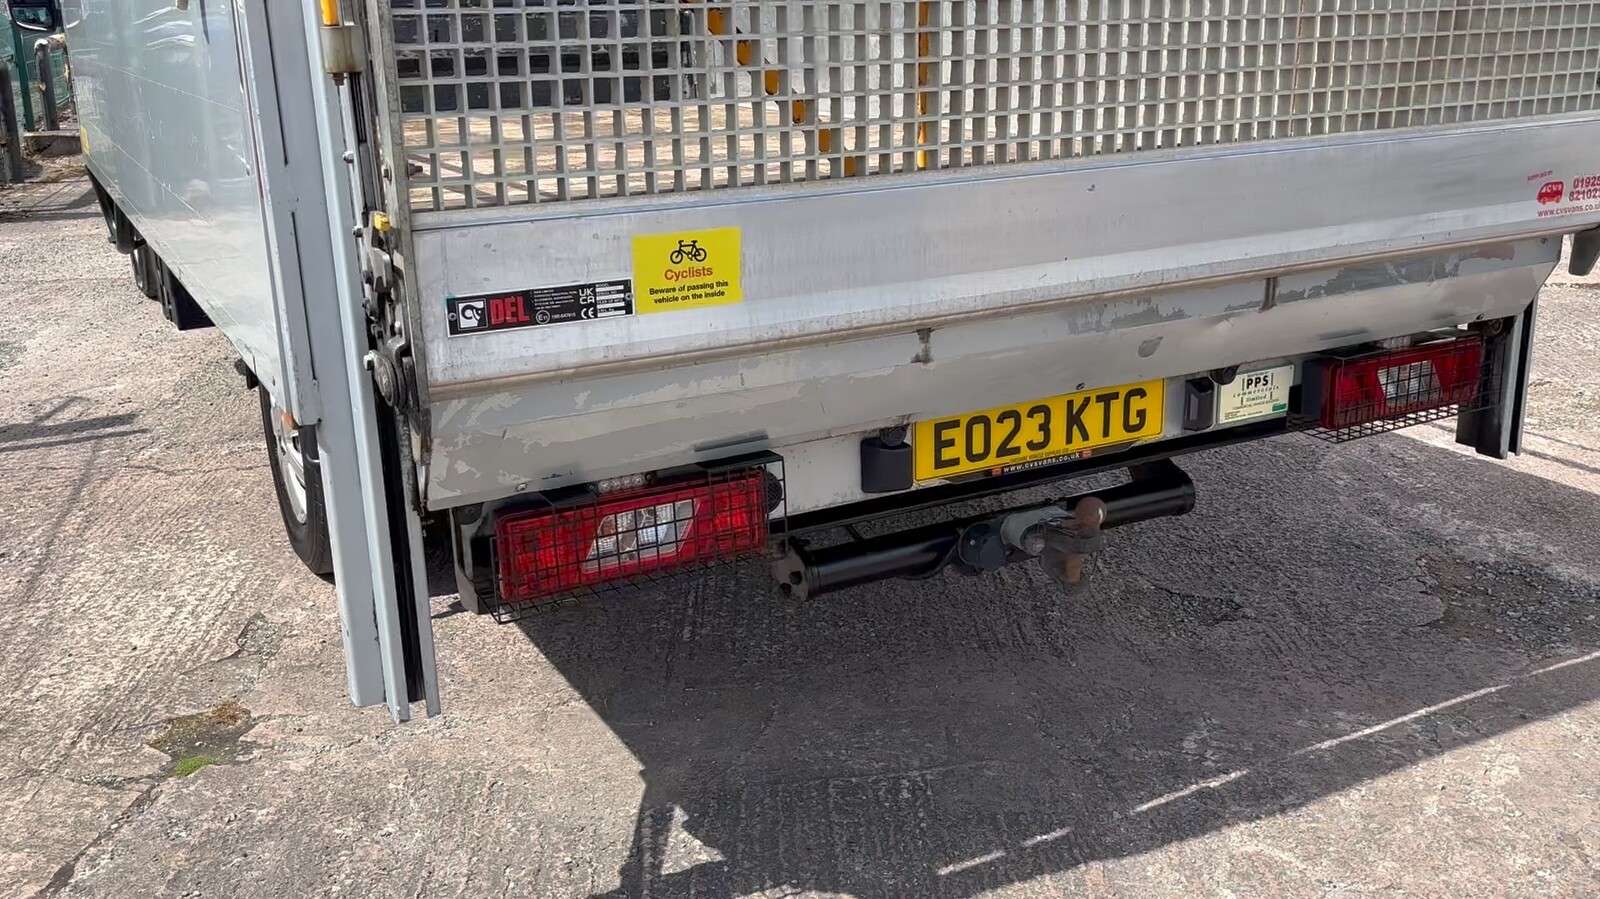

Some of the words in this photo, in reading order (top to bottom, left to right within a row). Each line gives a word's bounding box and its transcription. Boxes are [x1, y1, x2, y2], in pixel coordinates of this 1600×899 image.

[1568, 187, 1600, 202] 82102
[664, 266, 713, 282] Cyclists
[649, 287, 676, 296] Beware
[678, 284, 686, 292] of
[687, 282, 714, 292] passing
[715, 280, 729, 288] this
[654, 295, 679, 304] vehicle
[691, 291, 703, 300] the
[704, 289, 725, 299] inside
[489, 296, 530, 325] DEL
[1246, 375, 1269, 390] PPS
[934, 404, 1052, 470] EO23
[1065, 387, 1147, 445] KTG
[1003, 452, 1080, 473] www.cvsvans.co.uk
